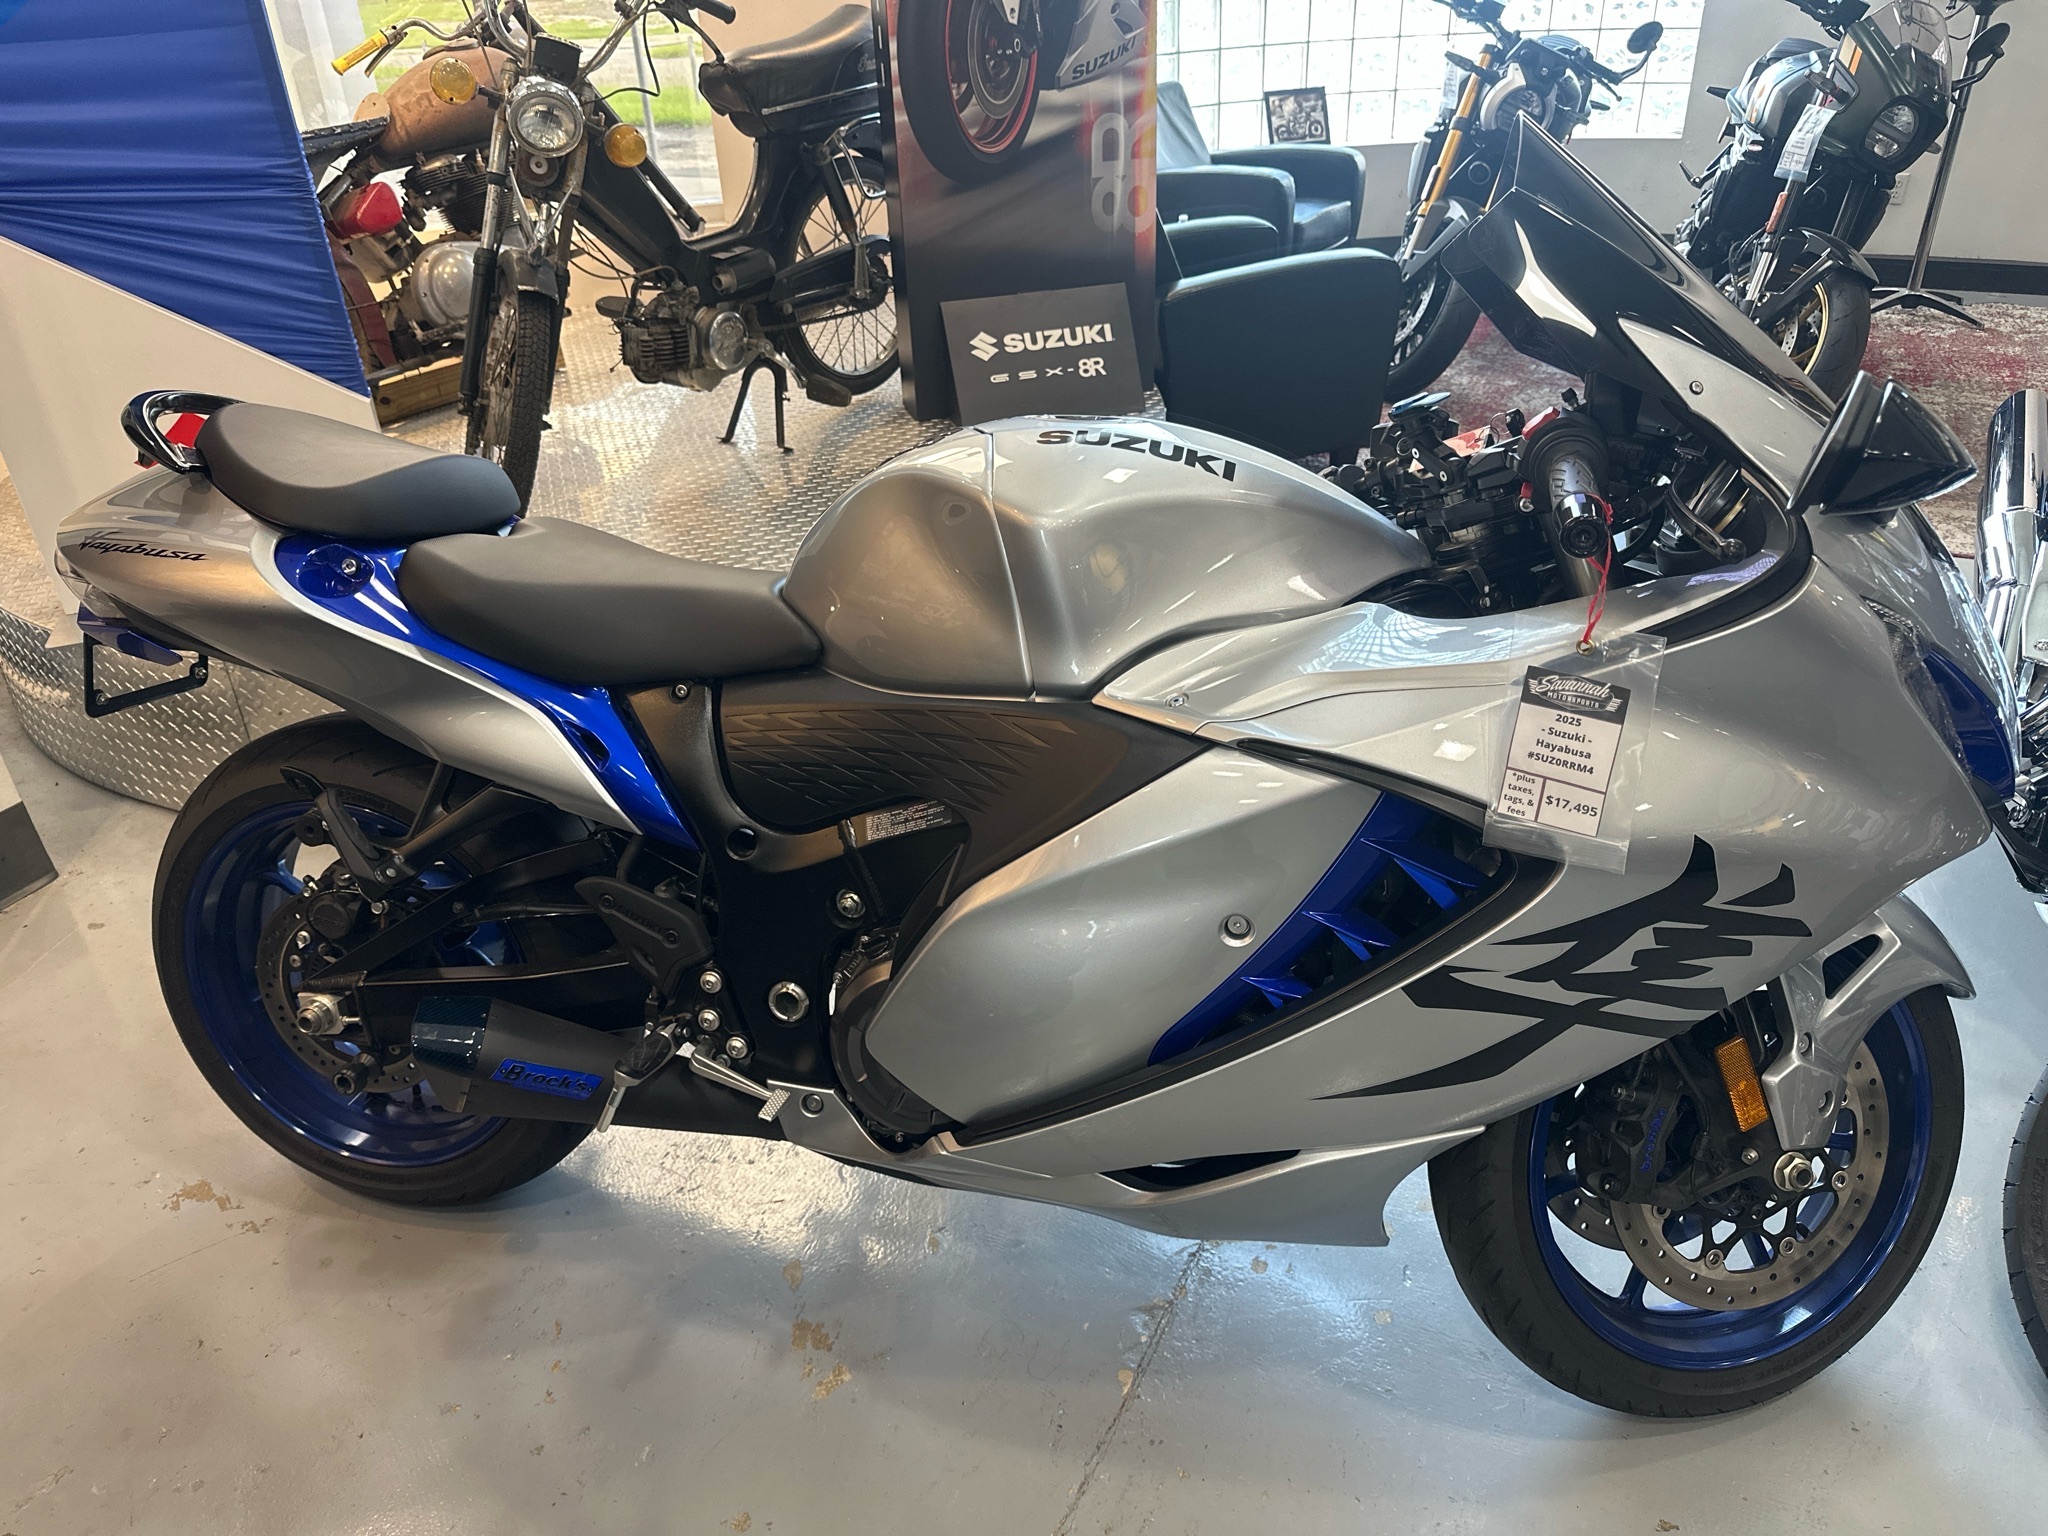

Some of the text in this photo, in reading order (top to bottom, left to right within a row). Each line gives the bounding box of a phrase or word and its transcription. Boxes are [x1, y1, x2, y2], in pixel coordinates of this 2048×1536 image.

[1072, 36, 1136, 81] SUZUKI
[1003, 322, 1113, 354] SUZUKI
[1036, 430, 1237, 482] SUZUKI
[1536, 674, 1611, 698] Savannah
[1546, 691, 1600, 709] MOTORSPORTS
[1555, 713, 1582, 727] 2025
[1547, 726, 1586, 743] Suzuki
[1535, 738, 1592, 760] Hayabusa
[1503, 793, 1535, 807] tags, &
[1508, 782, 1534, 796] taxes,
[1507, 804, 1526, 817] fees
[1545, 795, 1598, 818] $17,495
[504, 1063, 588, 1091] Brock's
